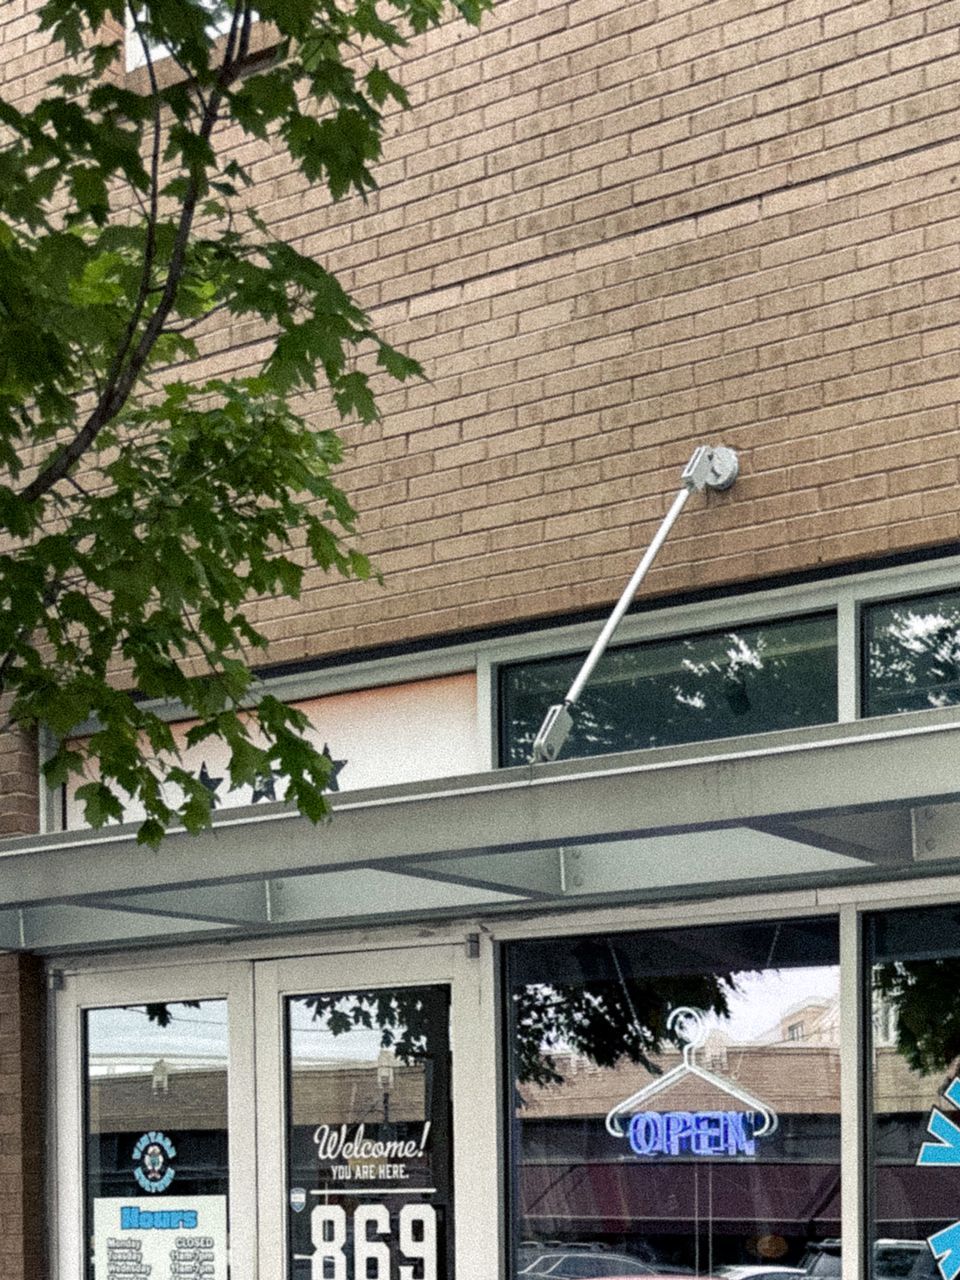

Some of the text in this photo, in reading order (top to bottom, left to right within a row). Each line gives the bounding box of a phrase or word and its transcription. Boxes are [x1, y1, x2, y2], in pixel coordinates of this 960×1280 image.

[313, 1121, 431, 1160] Welcome!
[629, 1111, 756, 1156] OPEN
[331, 1164, 409, 1180] YOU ARE HERE.
[120, 1206, 198, 1230] Hours
[175, 1237, 214, 1250] CLOSED
